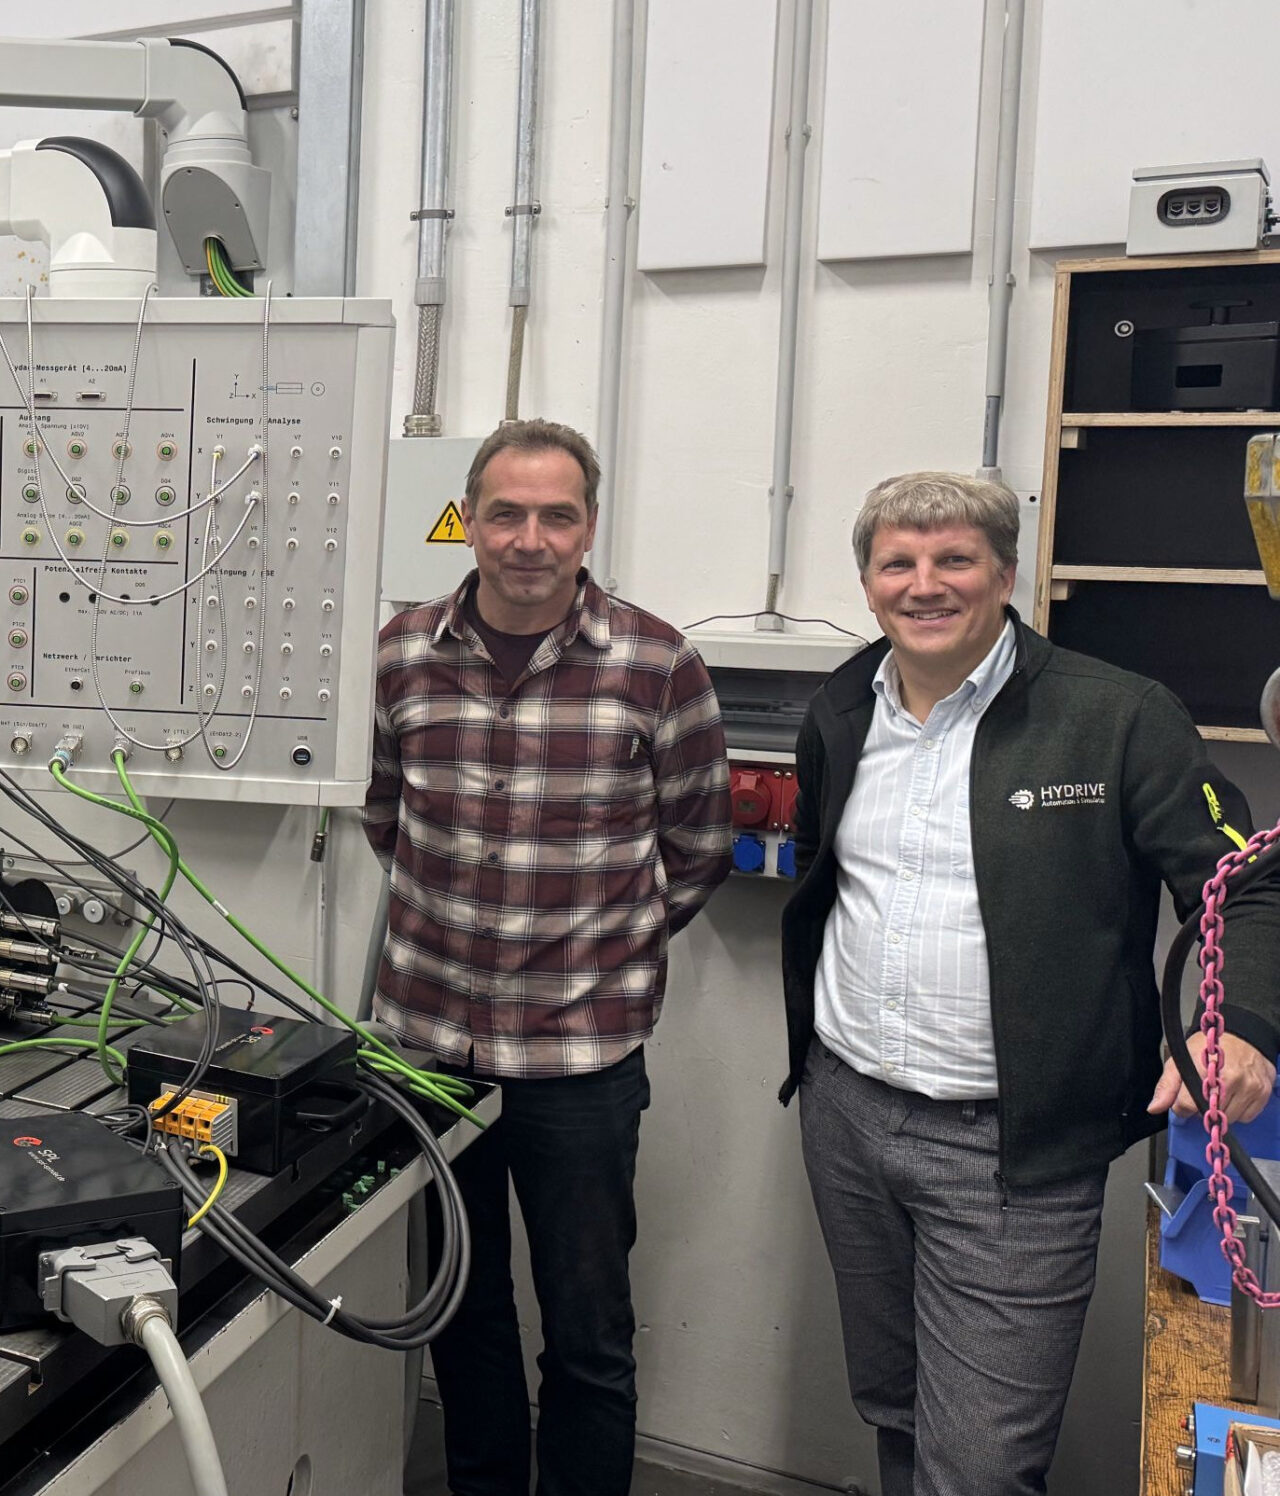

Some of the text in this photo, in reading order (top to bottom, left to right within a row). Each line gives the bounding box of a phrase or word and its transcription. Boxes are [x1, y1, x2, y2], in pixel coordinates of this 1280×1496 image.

[19, 414, 51, 422] Ausang
[206, 417, 254, 425] Schwingung
[267, 417, 301, 425] Analyse
[111, 566, 148, 575] Kontakte
[1041, 783, 1106, 800] HYDRIVE
[37, 1149, 61, 1163] SPL
